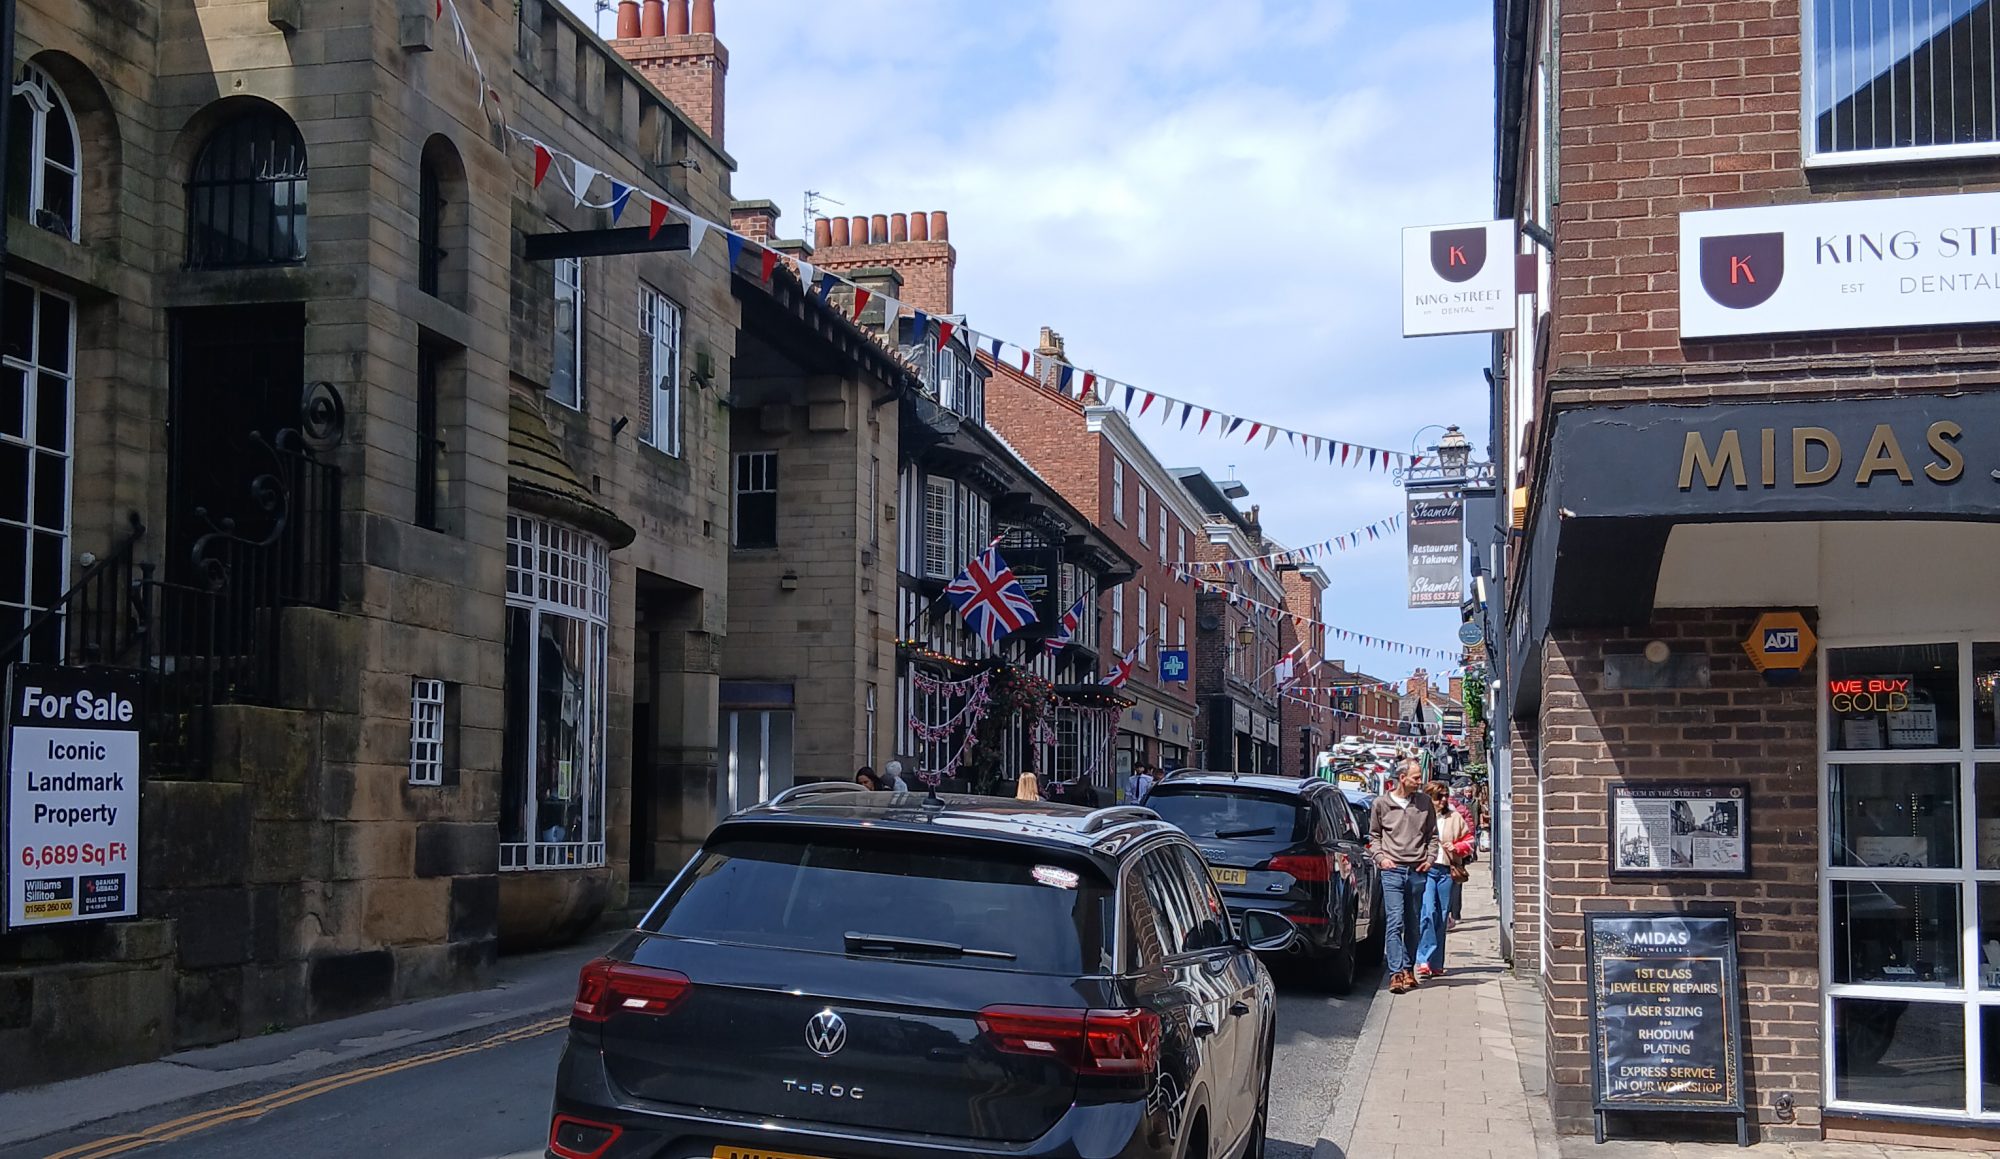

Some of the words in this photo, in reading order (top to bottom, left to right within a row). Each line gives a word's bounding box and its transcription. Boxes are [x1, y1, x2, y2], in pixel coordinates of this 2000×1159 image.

[1816, 230, 1921, 265] KING
[1450, 245, 1467, 266] K
[1729, 254, 1756, 285] K
[1841, 283, 1865, 294] EST
[1415, 293, 1449, 306] KING
[1454, 289, 1502, 303] STREET
[1441, 306, 1475, 315] DENTAL
[1677, 420, 1965, 489] MIDAS
[1411, 500, 1460, 518] Shamoli
[1412, 544, 1458, 553] Restaurant
[1412, 555, 1419, 565] &
[1412, 576, 1460, 593] Shamoli
[1763, 631, 1799, 649] ADT
[1831, 680, 1863, 693] WE
[1868, 679, 1909, 692] BUY
[22, 686, 72, 719] For
[75, 689, 134, 722] Sale
[1832, 692, 1908, 712] GOLD
[48, 739, 106, 761] Iconic
[28, 771, 124, 792] Landmark
[1705, 788, 1712, 797] 5
[34, 803, 117, 827] Property
[22, 844, 78, 869] 6,689
[81, 843, 105, 866] Sq
[109, 842, 127, 862] Ft
[1215, 869, 1239, 882] YCR
[26, 881, 62, 891] Williams
[60, 902, 72, 910] 000
[1633, 932, 1688, 945] MIDAS
[1635, 968, 1655, 979] 1ST
[1657, 968, 1693, 980] CLASS
[1609, 982, 1670, 996] JEWELLERY
[1672, 983, 1718, 994] REPAIRS
[1627, 1005, 1662, 1017] LASER
[1664, 1006, 1703, 1017] SIZING
[1638, 1029, 1694, 1040] RHODIUM
[1643, 1043, 1691, 1055] PLATING
[1620, 1066, 1668, 1077] EXPRESS
[1670, 1067, 1716, 1079] SERVICE
[783, 1080, 864, 1099] T-ROC
[1615, 1080, 1628, 1091] IN
[1630, 1081, 1655, 1092] OUR
[1657, 1081, 1723, 1094] WORKSHOP
